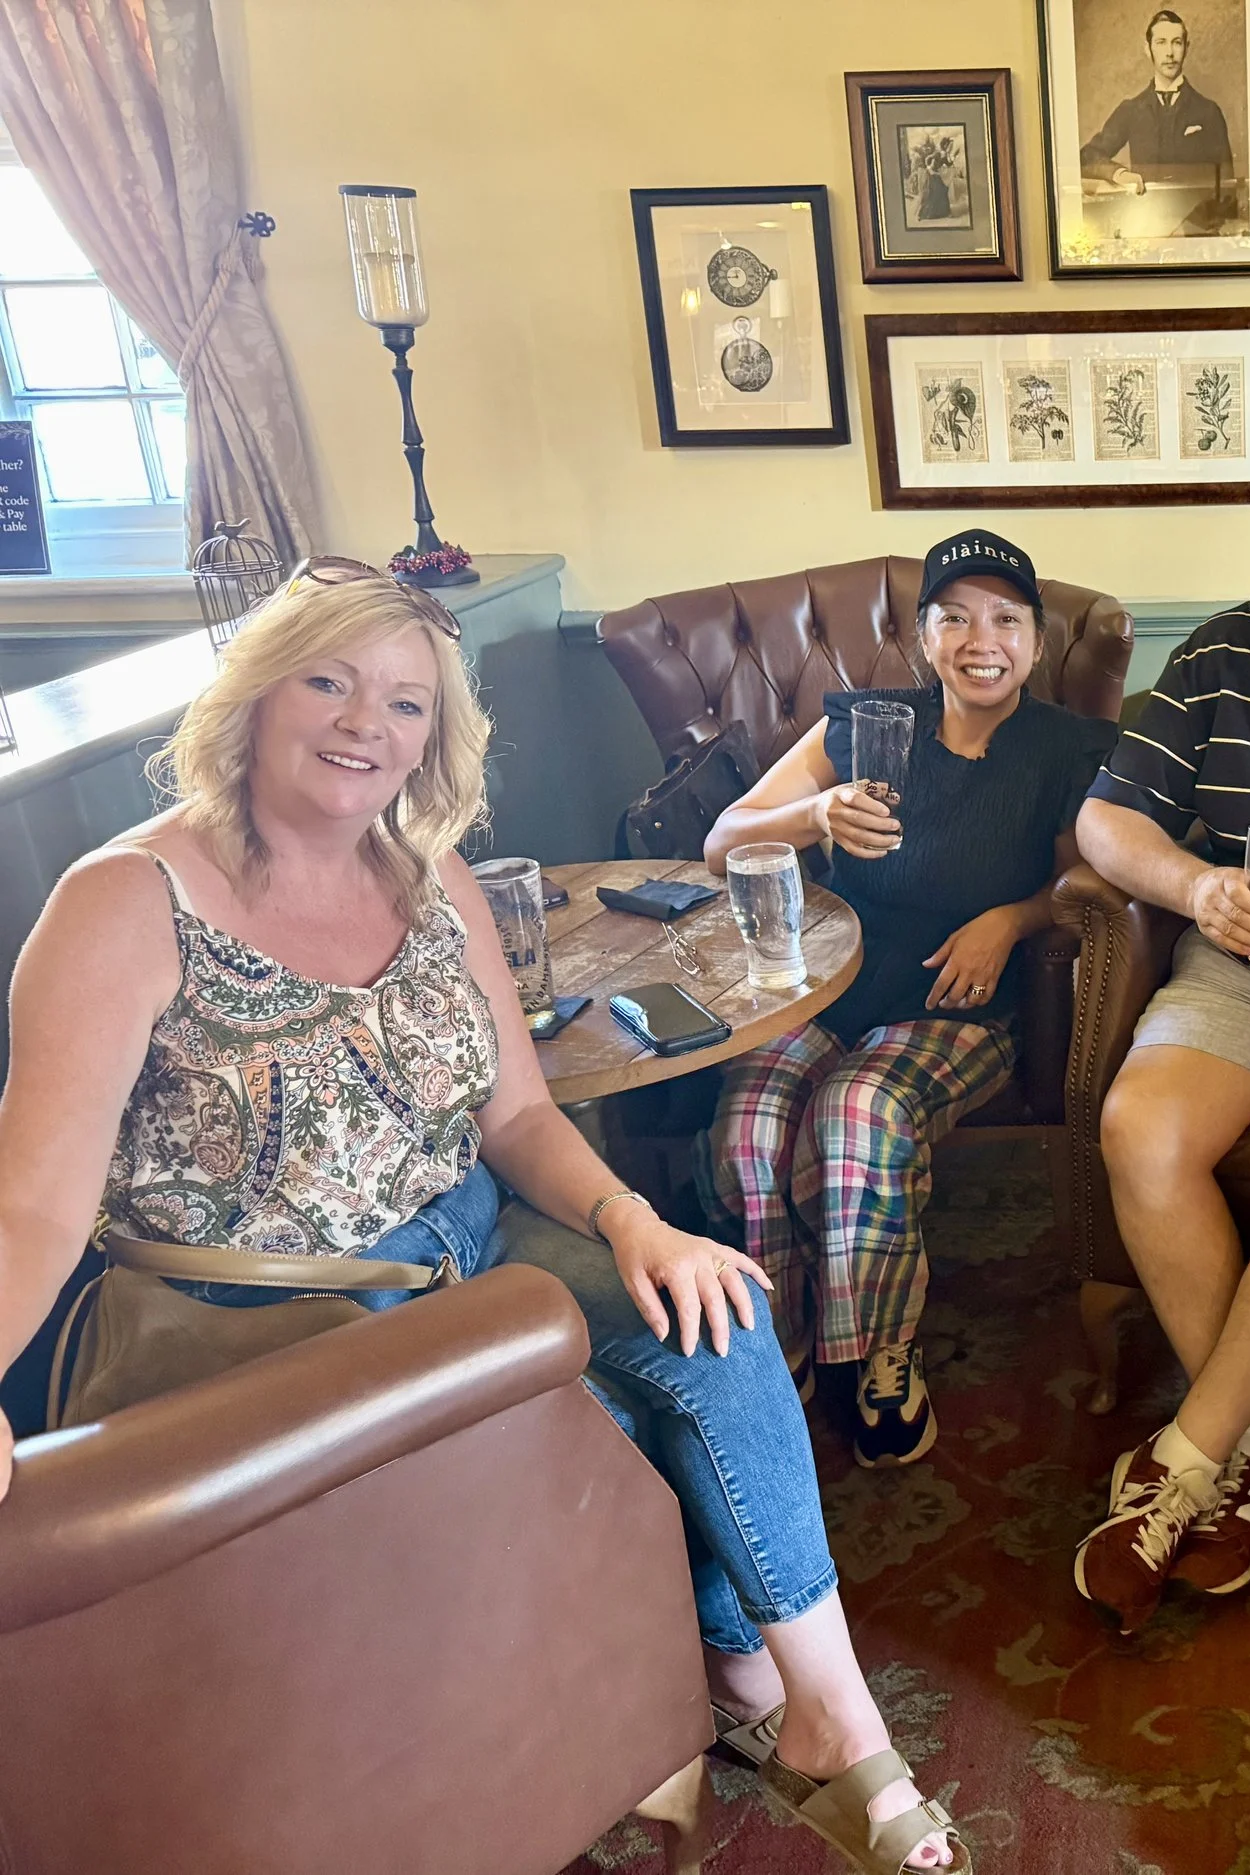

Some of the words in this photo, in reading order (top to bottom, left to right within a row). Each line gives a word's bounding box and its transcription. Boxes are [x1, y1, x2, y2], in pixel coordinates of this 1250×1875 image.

[0, 459, 23, 470] her?
[5, 495, 29, 506] code
[7, 509, 25, 521] Pay
[3, 521, 27, 532] table
